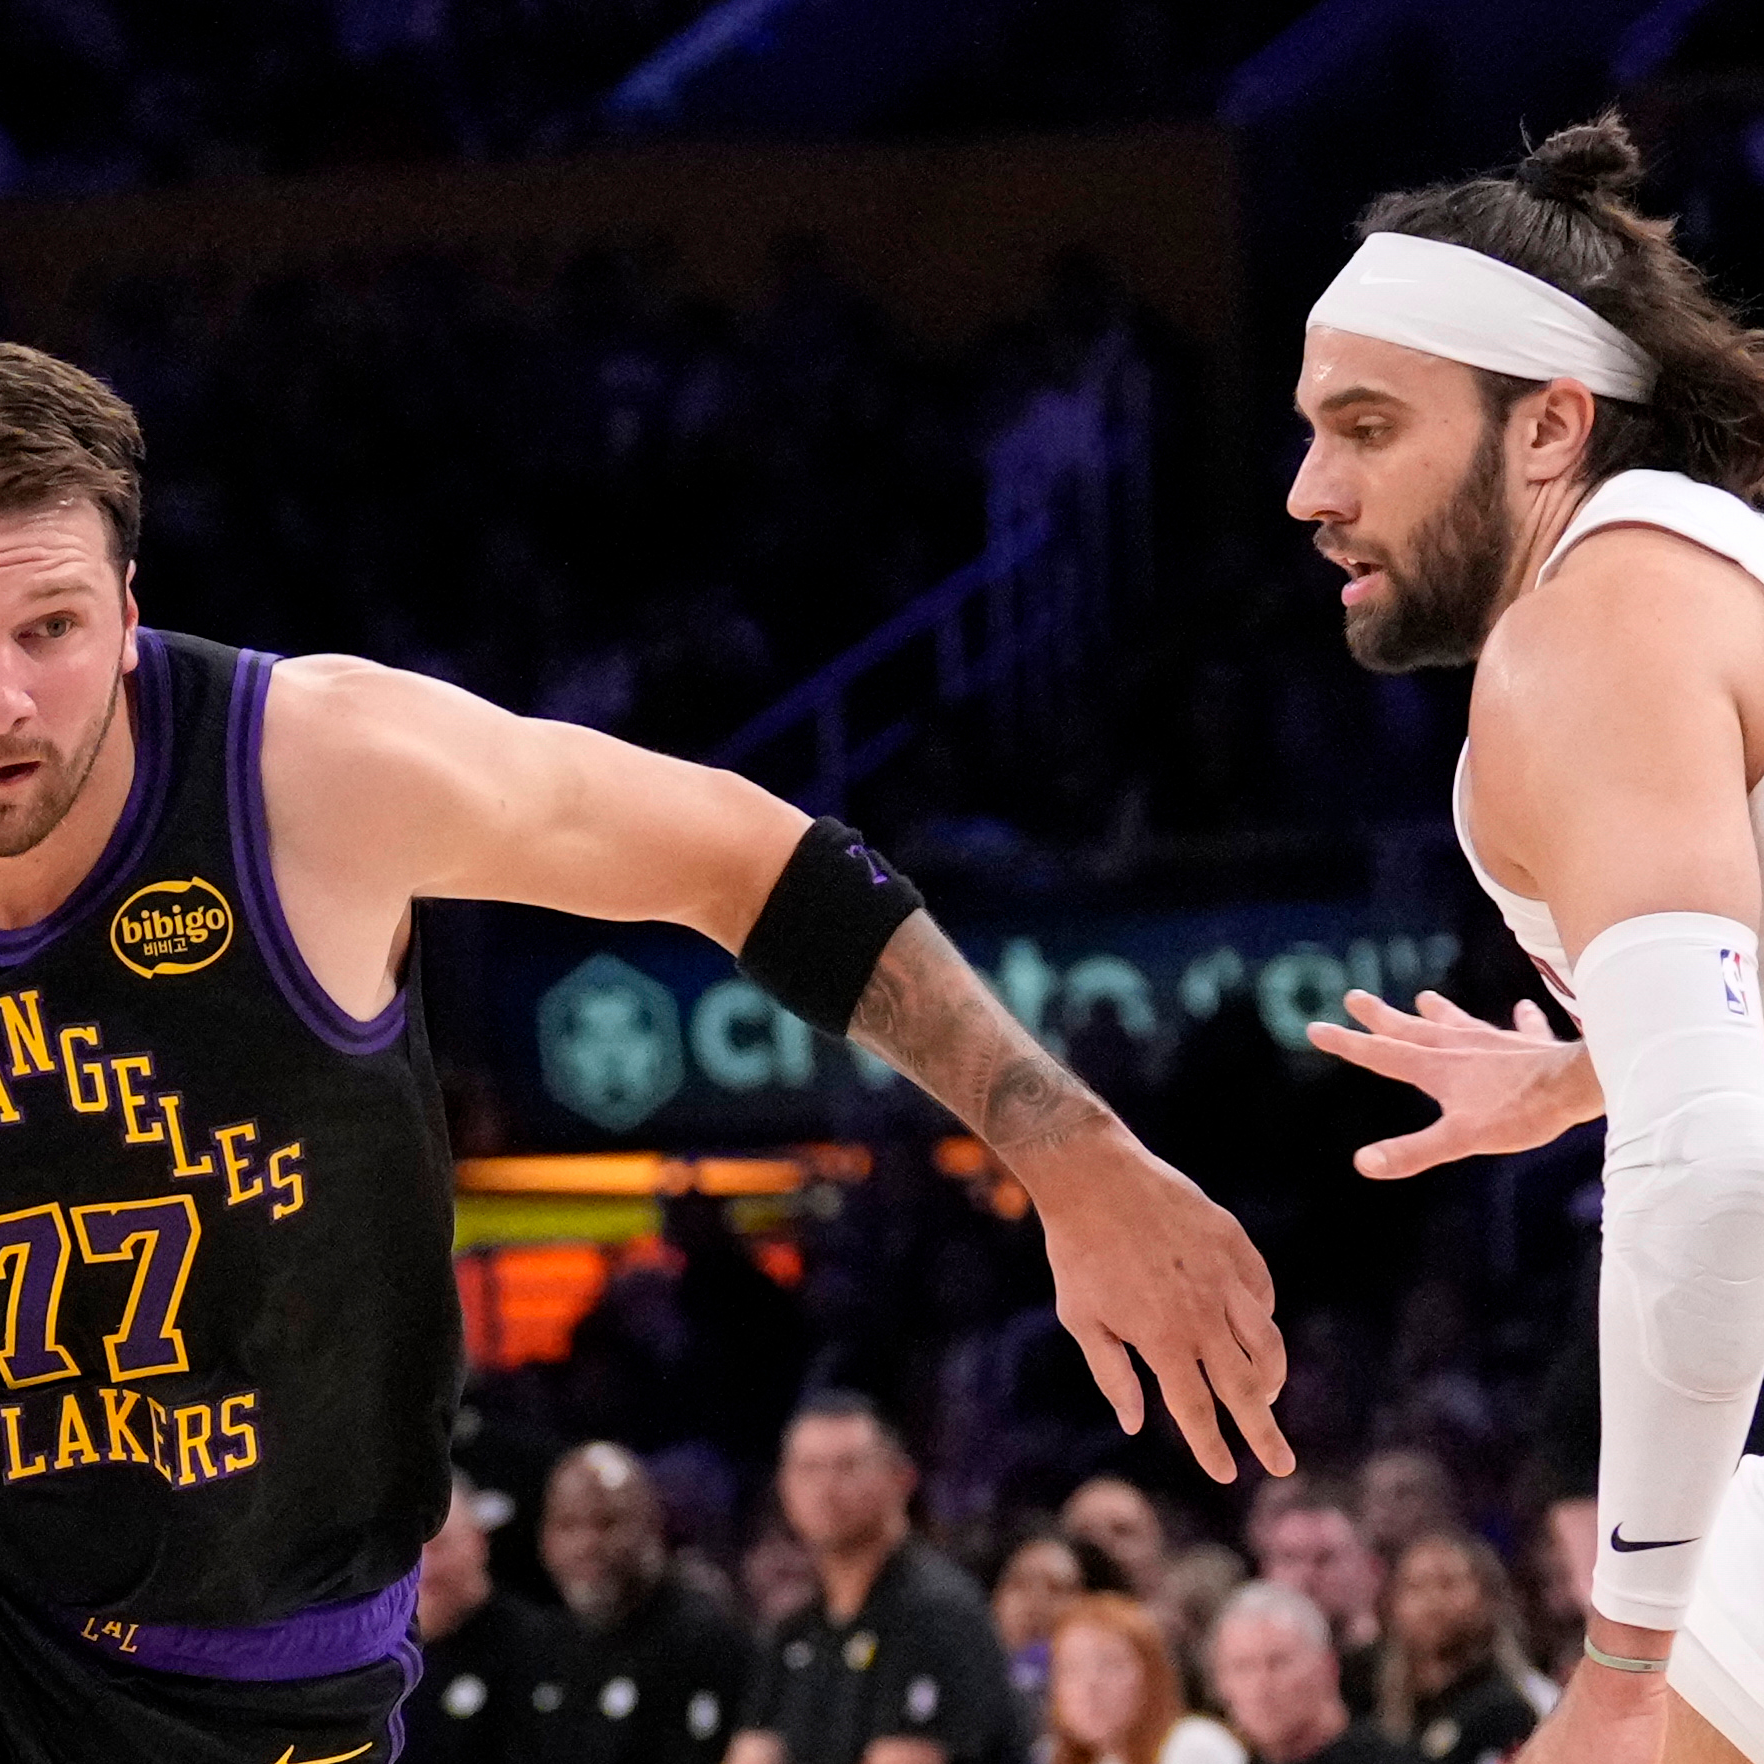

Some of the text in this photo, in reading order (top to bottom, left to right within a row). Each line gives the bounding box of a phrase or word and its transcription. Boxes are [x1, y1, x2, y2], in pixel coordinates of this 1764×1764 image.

[120, 904, 226, 944] bibigo
[143, 937, 189, 957] 비비고
[80, 1617, 140, 1653] LAL
